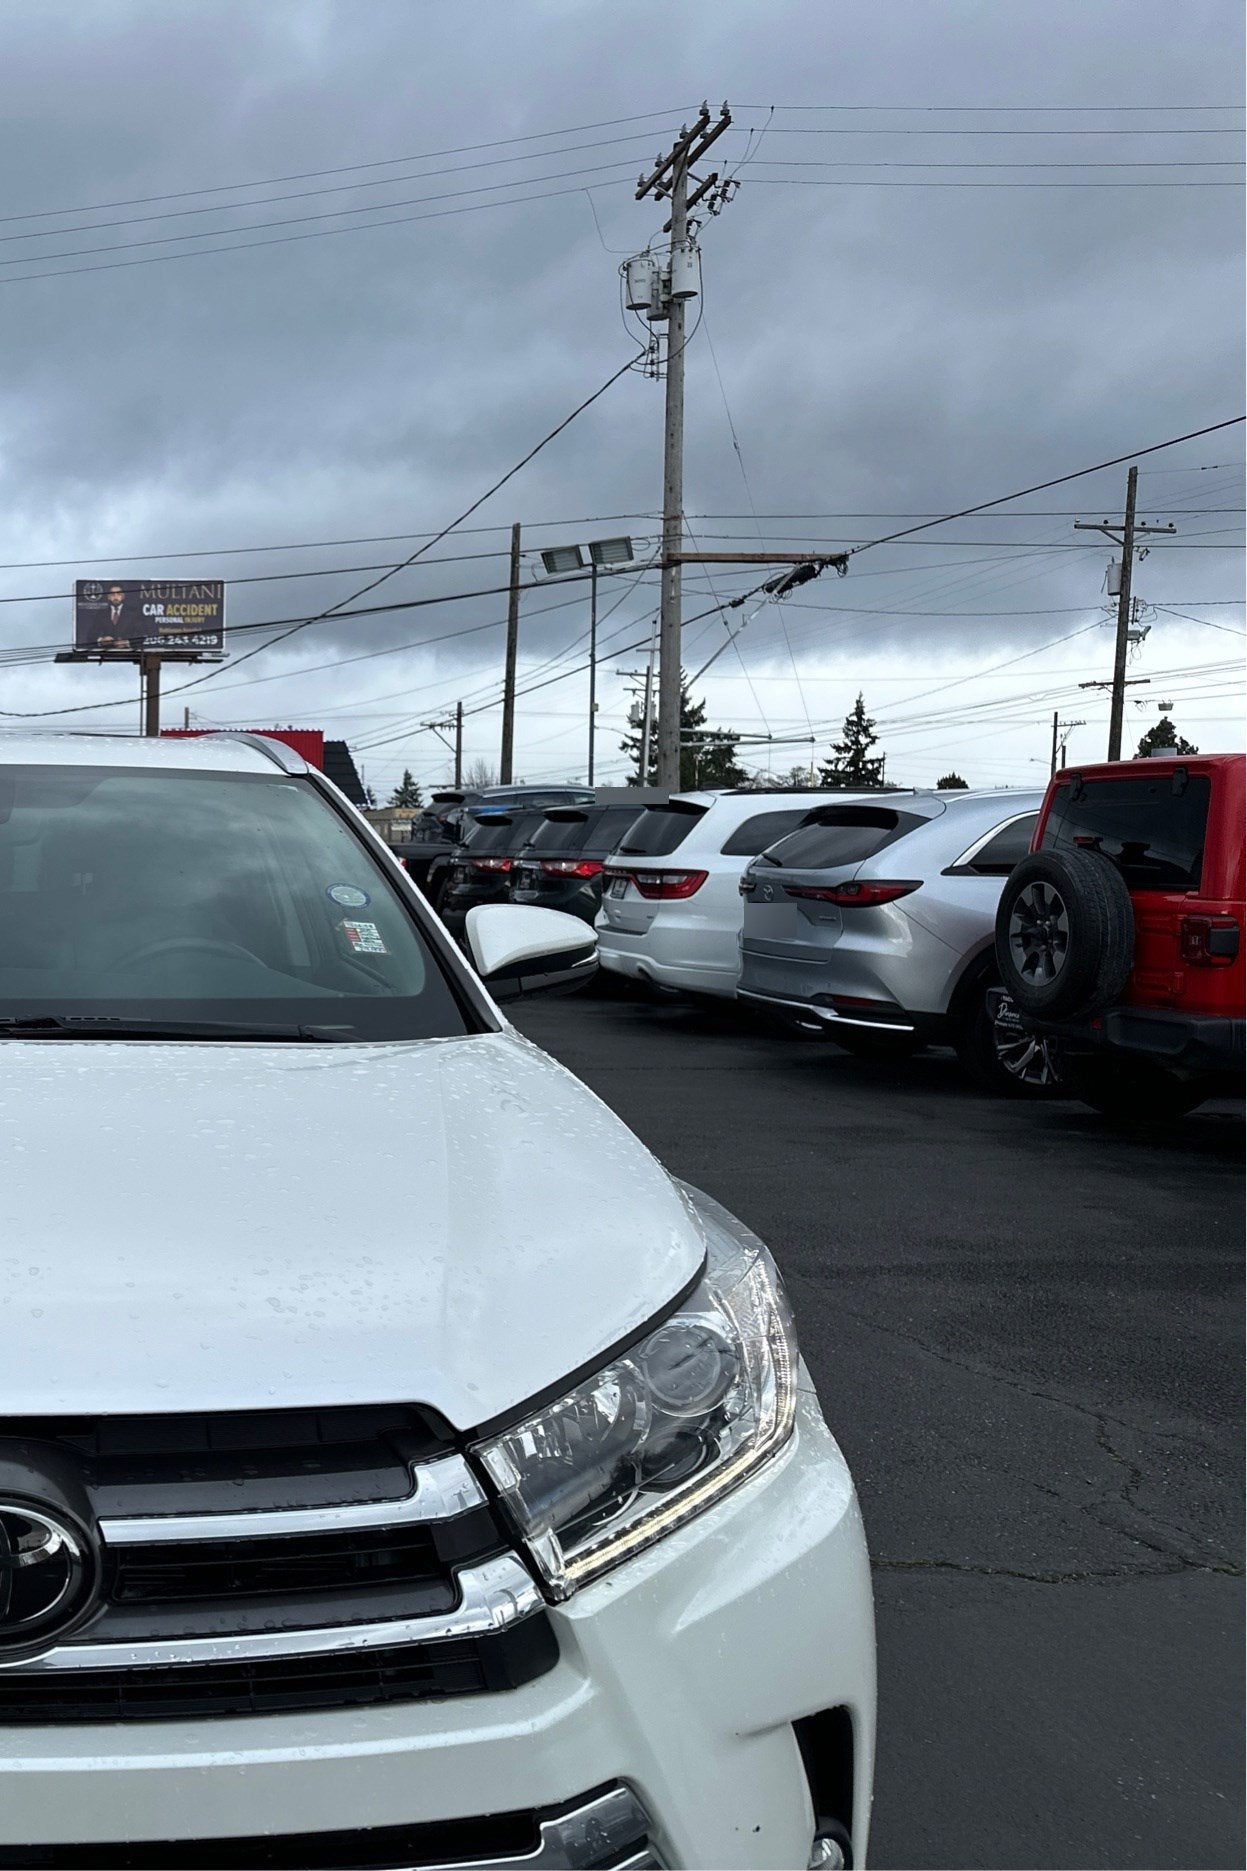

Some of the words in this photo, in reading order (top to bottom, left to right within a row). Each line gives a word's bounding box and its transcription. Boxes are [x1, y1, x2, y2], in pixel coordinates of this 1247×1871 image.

[140, 584, 221, 599] MULTANI
[143, 604, 164, 616] CAR
[167, 604, 218, 616] ACCIDENT
